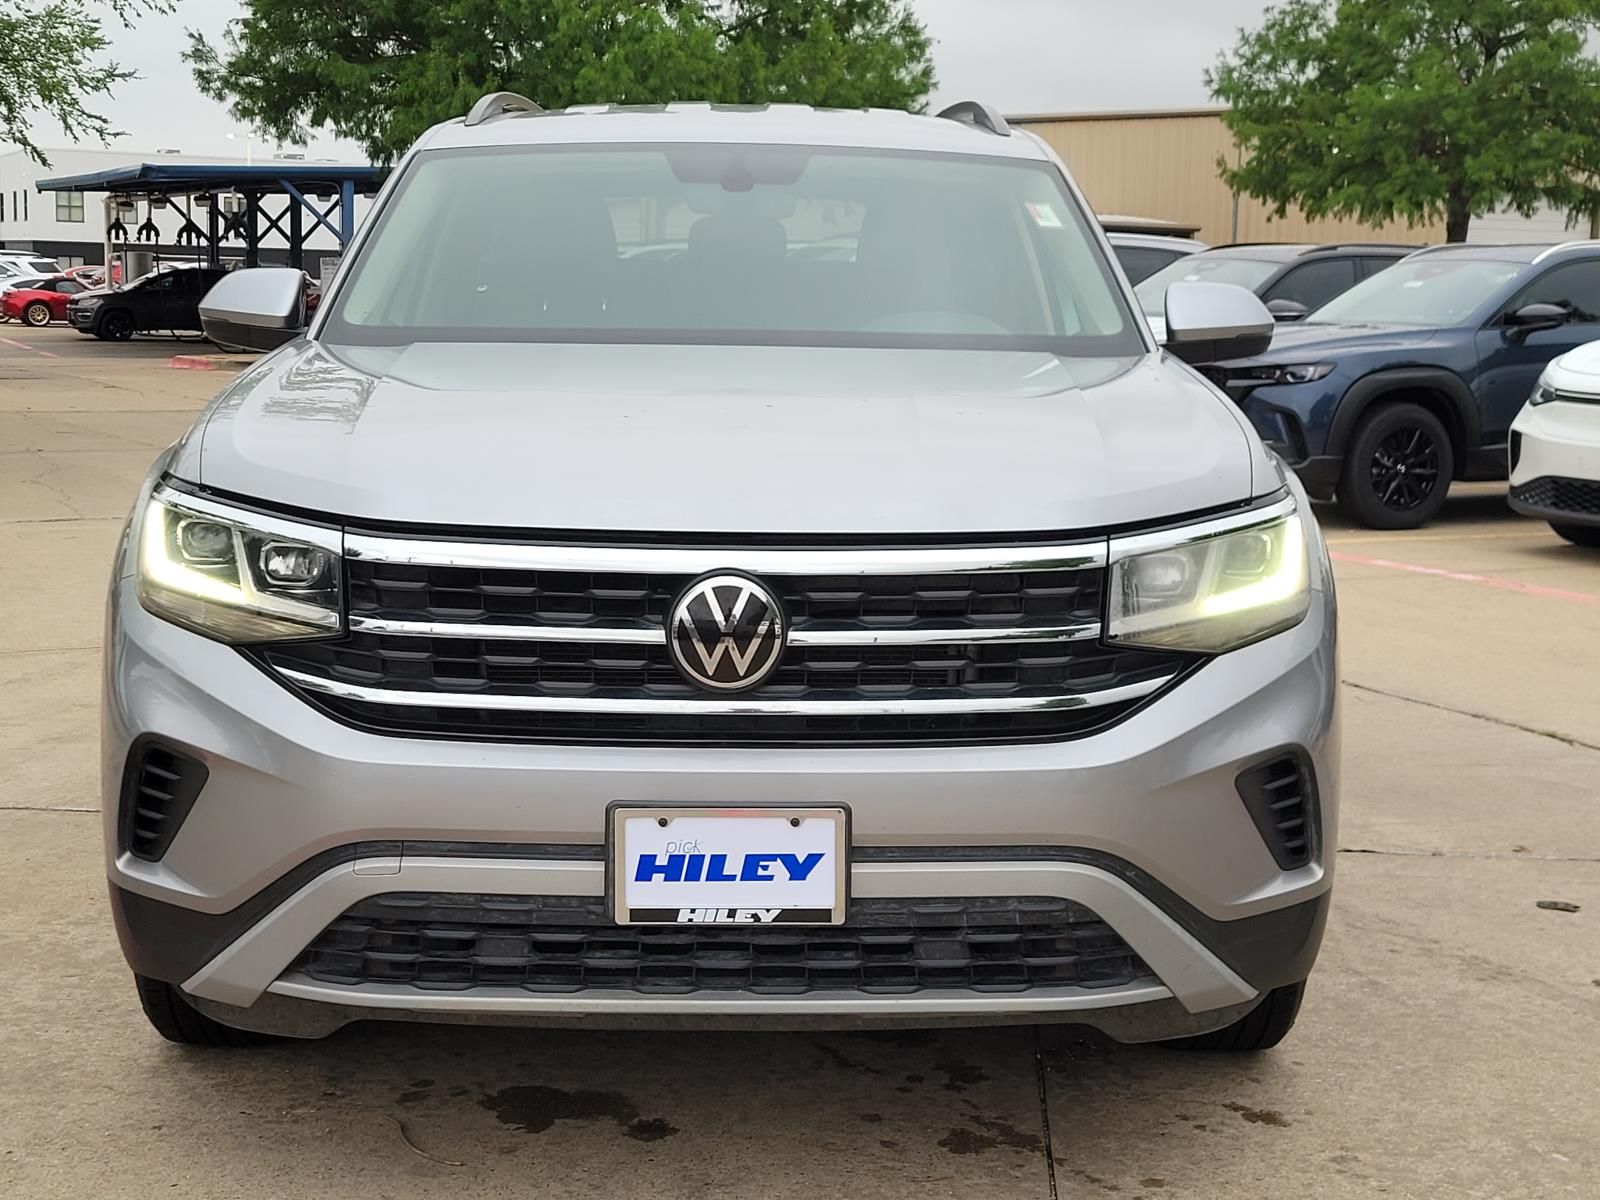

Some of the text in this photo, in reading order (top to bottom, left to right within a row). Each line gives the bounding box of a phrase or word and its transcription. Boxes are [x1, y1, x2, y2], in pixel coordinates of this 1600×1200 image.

[676, 580, 777, 684] VW
[665, 839, 702, 856] pick
[634, 853, 826, 882] HILEY
[677, 908, 782, 923] HILEY
